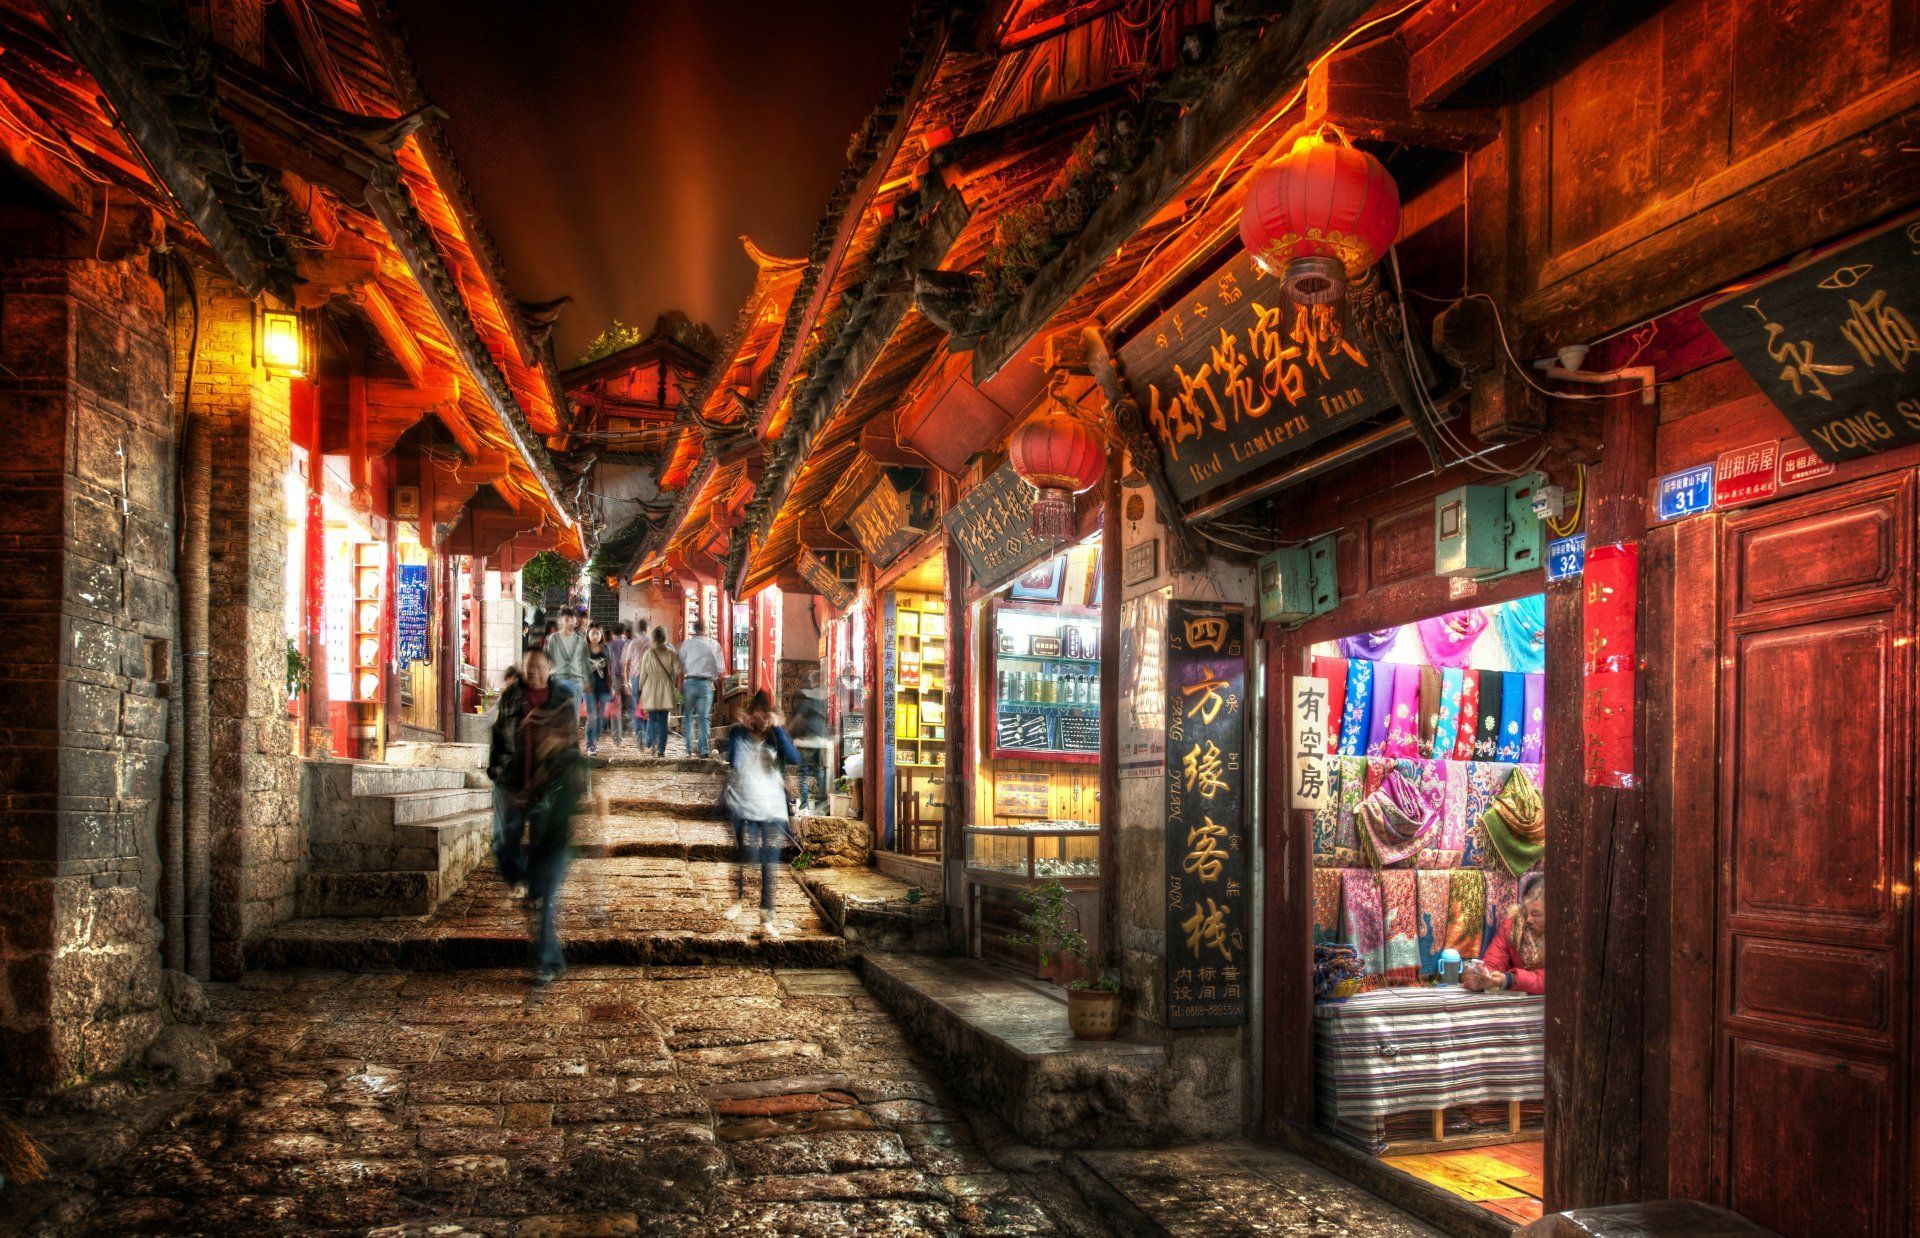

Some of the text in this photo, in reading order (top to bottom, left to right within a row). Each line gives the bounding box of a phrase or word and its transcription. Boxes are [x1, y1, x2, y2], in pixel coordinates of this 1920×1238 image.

[1149, 301, 1369, 462] 红灯笼客栈
[1811, 398, 1920, 453] YONG S
[1187, 386, 1365, 485] Red Lantern Inn
[1718, 446, 1774, 482] 出租房屋
[1675, 489, 1695, 510] 31
[1560, 554, 1577, 573] 32
[1168, 632, 1184, 912] SI FANG YUAN INN
[1181, 616, 1233, 962] 四方缘客栈
[1295, 686, 1326, 800] 有空房
